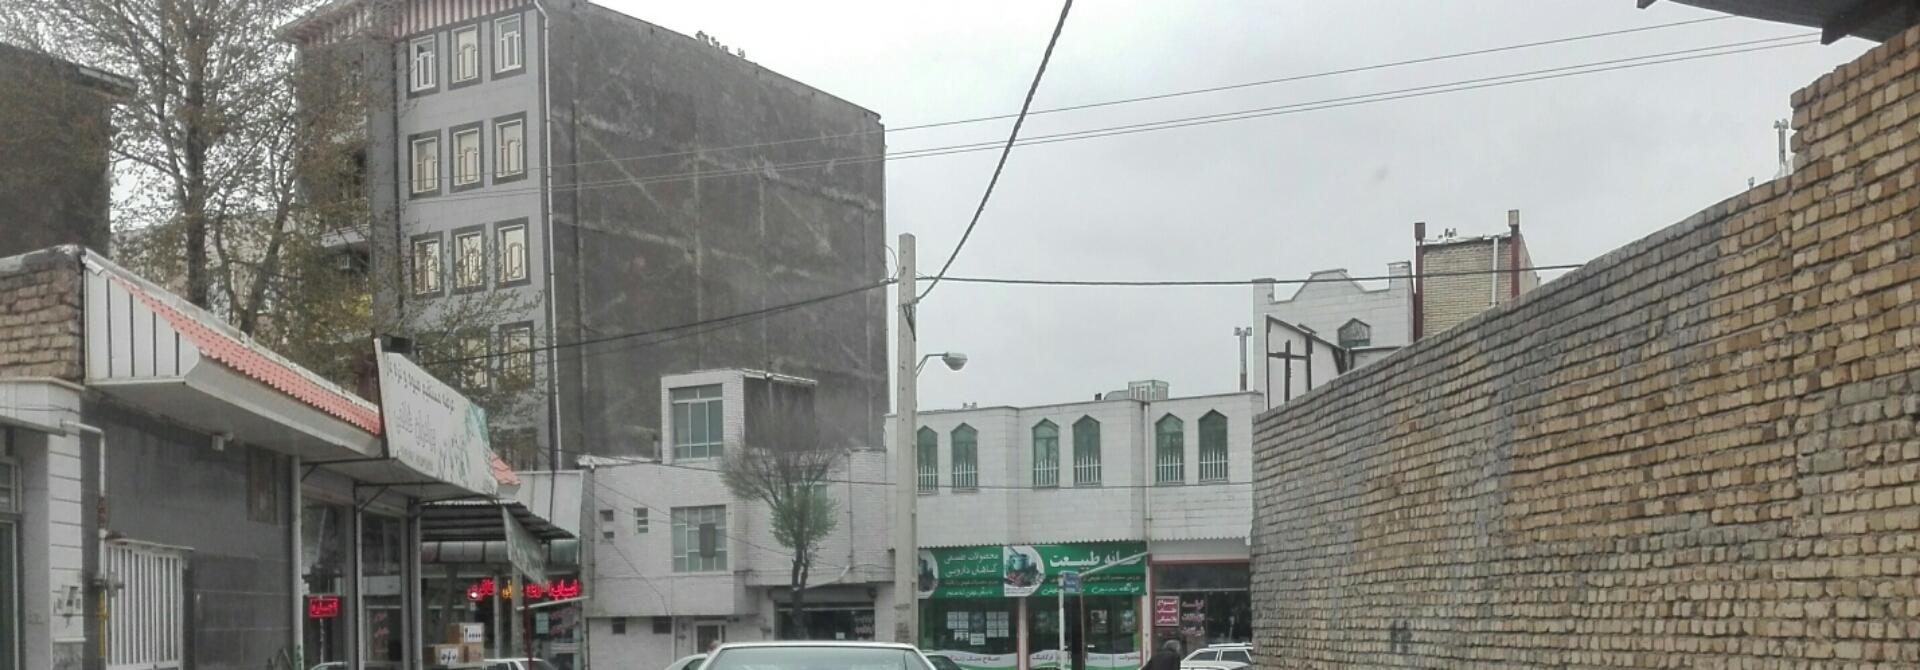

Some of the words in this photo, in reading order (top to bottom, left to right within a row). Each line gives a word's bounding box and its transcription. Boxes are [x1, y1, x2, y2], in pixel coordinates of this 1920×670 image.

[967, 552, 999, 563] محصولات
[1049, 550, 1101, 570] طبیعت
[944, 567, 970, 578] دارویی
[971, 563, 998, 576] گیاهان
